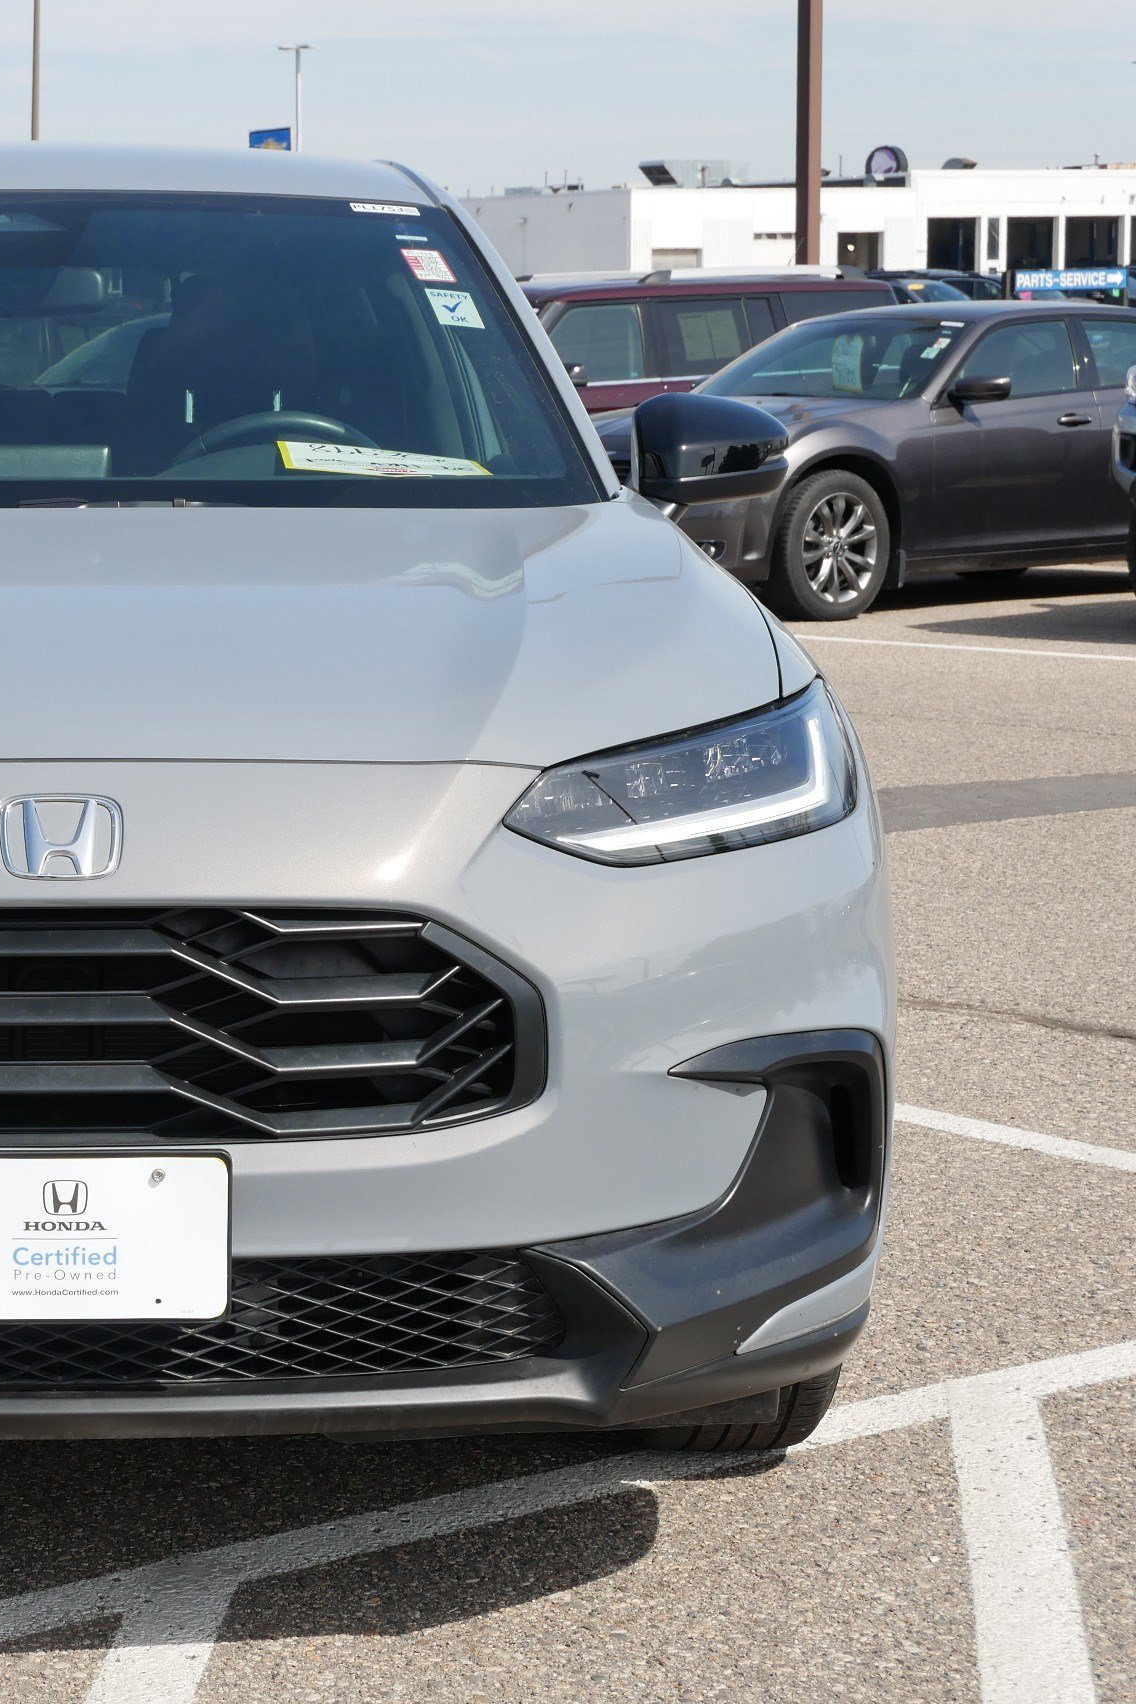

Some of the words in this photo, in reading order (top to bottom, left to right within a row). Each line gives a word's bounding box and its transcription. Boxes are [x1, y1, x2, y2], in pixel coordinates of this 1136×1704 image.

[1016, 271, 1106, 288] PARTS-SERVICE
[429, 291, 468, 301] SAFETY
[450, 315, 469, 323] OK
[23, 1220, 108, 1232] HONDA
[12, 1245, 118, 1267] Certified
[13, 1268, 118, 1281] Pre-Owned
[11, 1288, 119, 1297] www.HondaCertified.com
